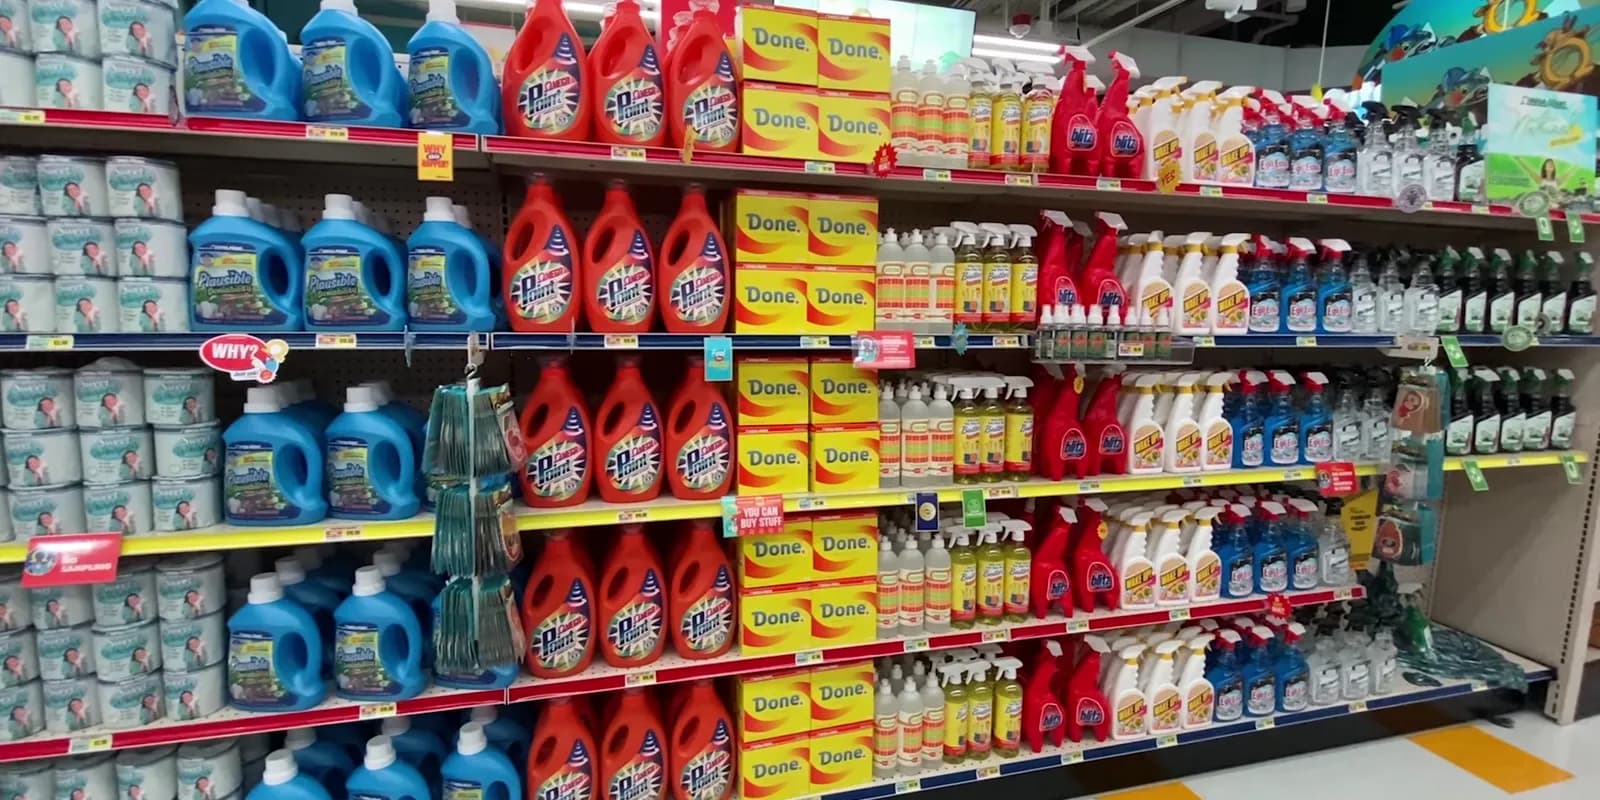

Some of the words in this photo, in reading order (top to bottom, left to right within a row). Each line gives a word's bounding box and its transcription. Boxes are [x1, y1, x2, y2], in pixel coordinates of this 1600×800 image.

[752, 27, 810, 52] Done.
[828, 38, 883, 60] Done.
[753, 108, 811, 130] Done.
[828, 113, 882, 136] Done.
[1071, 128, 1094, 145] blitz
[1115, 136, 1137, 150] blitz
[423, 144, 446, 154] WHY
[746, 213, 800, 233] Done.
[817, 217, 870, 236] Done.
[199, 270, 251, 288] Plausible
[310, 272, 357, 291] Plausible
[745, 286, 799, 305] Done.
[816, 288, 867, 305] Done.
[1101, 291, 1122, 305] blitz
[212, 343, 259, 360] WHY?
[747, 379, 801, 396] Done.
[821, 378, 871, 394] Done.
[747, 450, 801, 466] Done.
[824, 448, 872, 463] Done.
[744, 507, 760, 518] YOU
[762, 506, 778, 517] CAN
[741, 518, 758, 528] BUY
[759, 516, 782, 527] STUFF
[753, 540, 805, 558] Done.
[821, 536, 870, 551] Done.
[1090, 572, 1112, 588] blitz
[752, 609, 804, 627] Done.
[820, 603, 870, 619] Done.
[819, 683, 867, 701] Done.
[753, 694, 803, 713] Done.
[1080, 707, 1101, 722] blitz
[818, 747, 866, 766] Done.
[752, 759, 802, 779] Done.
